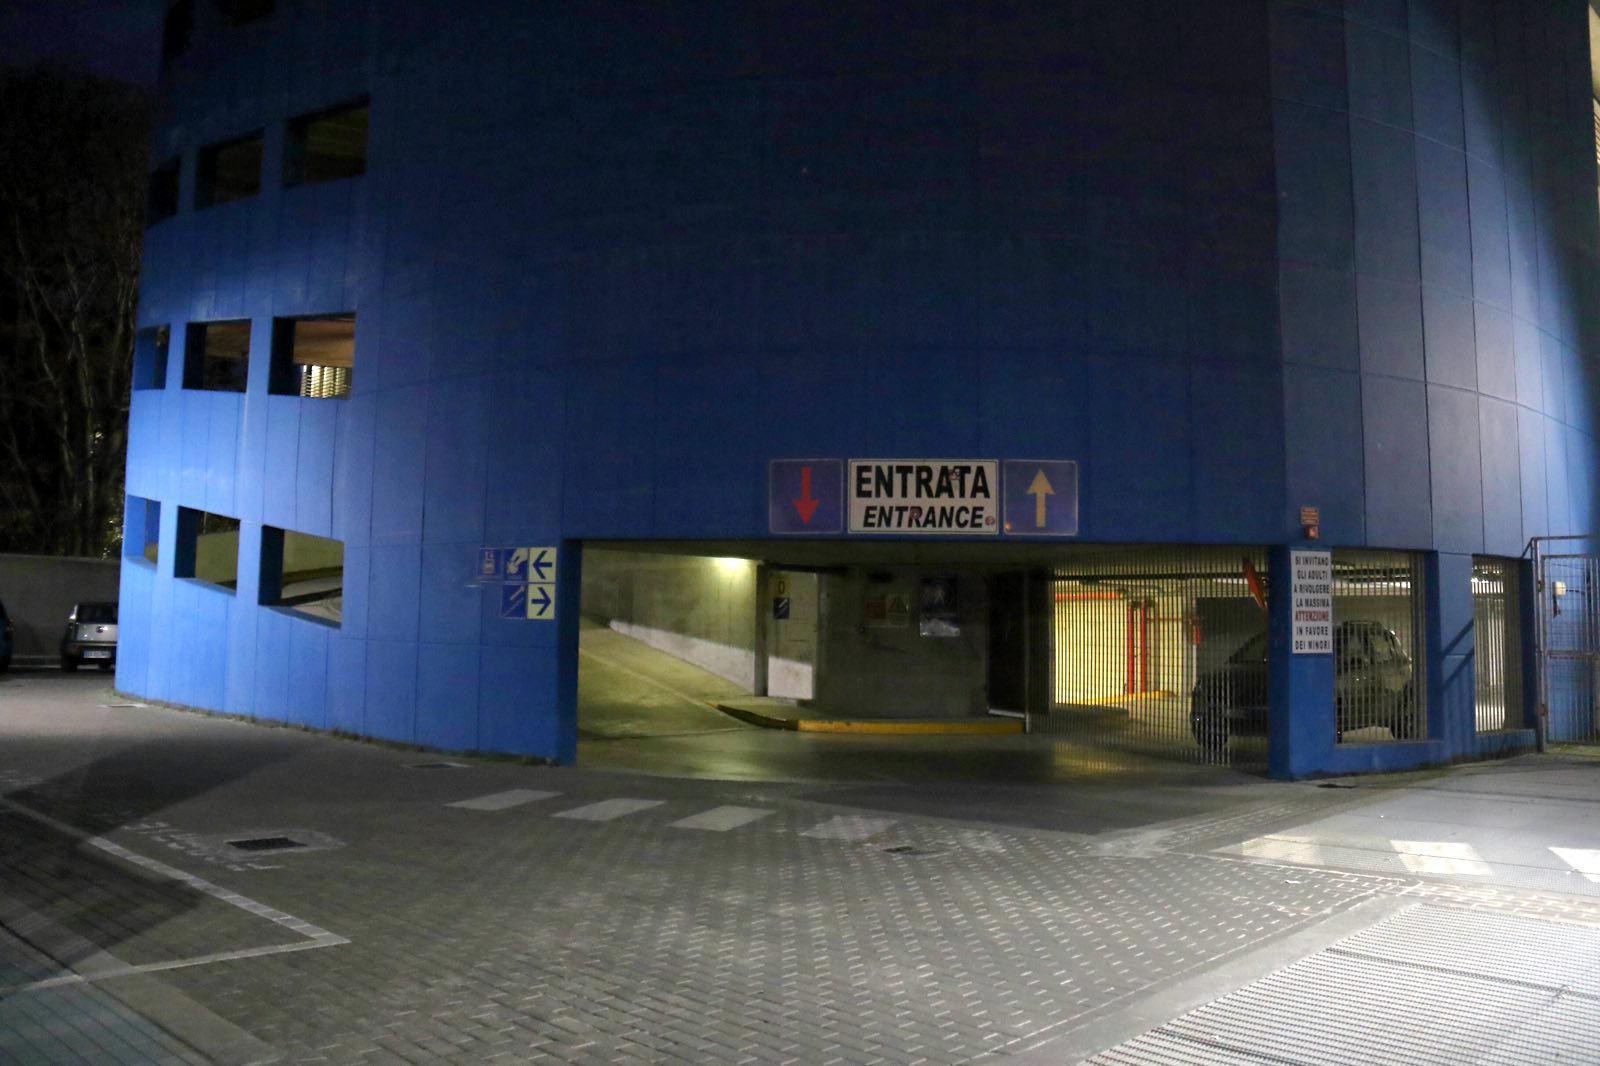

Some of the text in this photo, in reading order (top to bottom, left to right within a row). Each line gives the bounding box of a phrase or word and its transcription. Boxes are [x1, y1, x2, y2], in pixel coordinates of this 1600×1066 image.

[855, 466, 990, 498] ENTRATA
[863, 506, 984, 528] ENTRANCE
[1295, 556, 1329, 566] SI INVITANO
[1297, 570, 1328, 580] GLI ADULTI
[1299, 584, 1330, 594] RIVOLGERE
[1296, 598, 1330, 608] LA MASSIMA
[1295, 611, 1329, 622] ATTENZIONE
[1296, 626, 1329, 636] IN FAVORE
[1295, 640, 1330, 650] DEI MINORI
